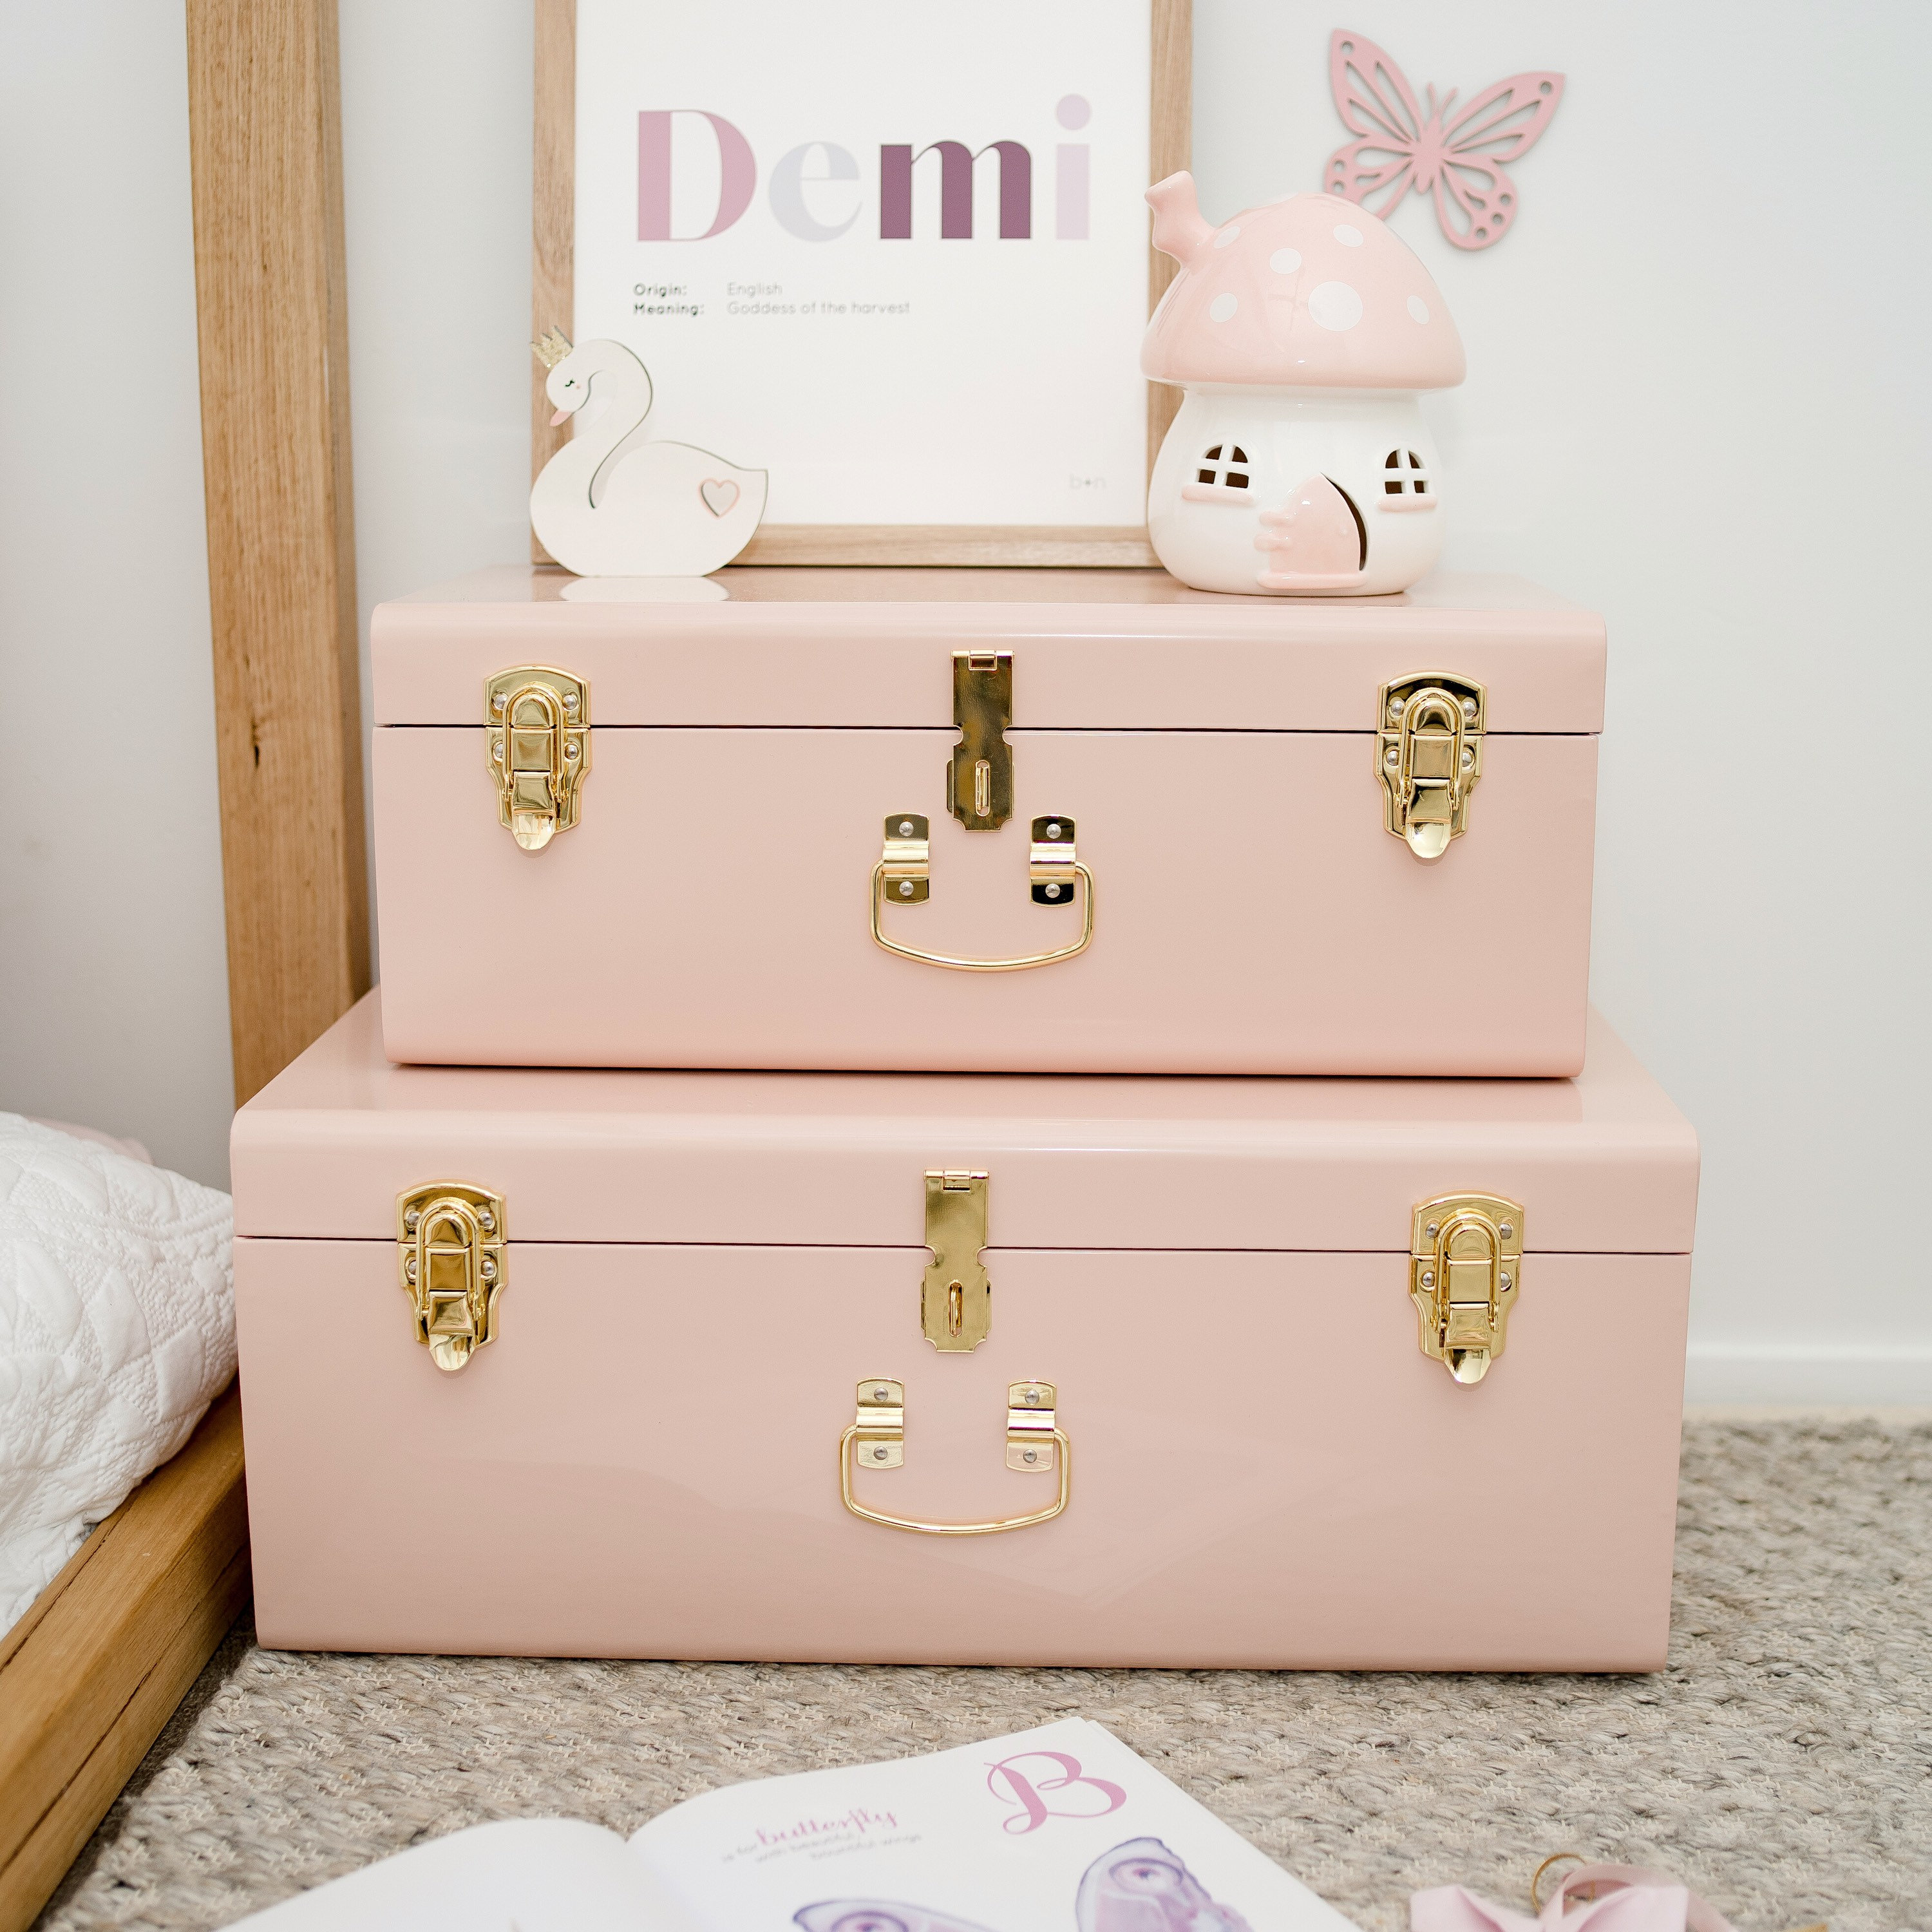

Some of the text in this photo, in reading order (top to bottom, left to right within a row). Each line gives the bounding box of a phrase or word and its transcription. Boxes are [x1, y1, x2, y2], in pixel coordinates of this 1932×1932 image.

[638, 94, 1092, 242] Demi
[633, 282, 782, 299] Origin: English
[634, 301, 910, 318] Meaning: Goddess of the harvest
[983, 1751, 1127, 1835] B
[756, 1808, 898, 1845] butterfly
